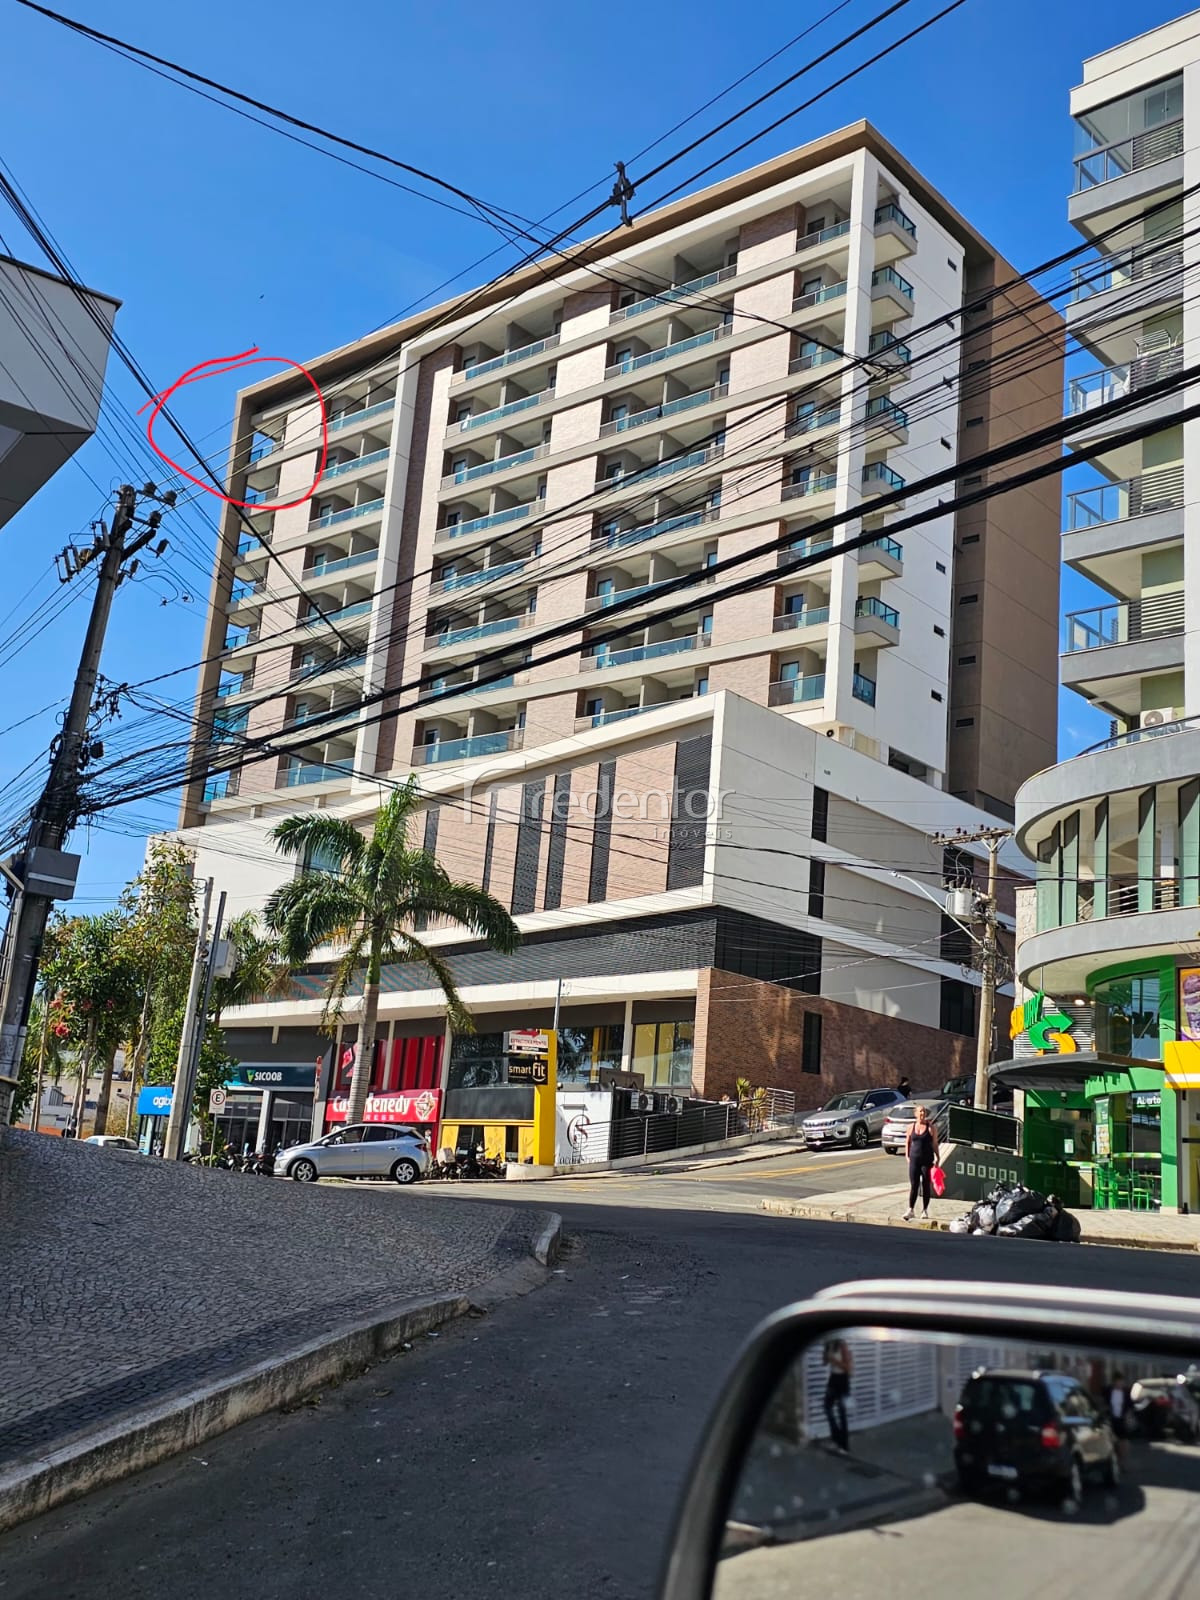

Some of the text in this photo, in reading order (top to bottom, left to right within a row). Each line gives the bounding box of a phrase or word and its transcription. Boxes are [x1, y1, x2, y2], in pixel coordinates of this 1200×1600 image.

[508, 1062, 546, 1077] smart fit
[254, 1071, 282, 1081] SICOOB
